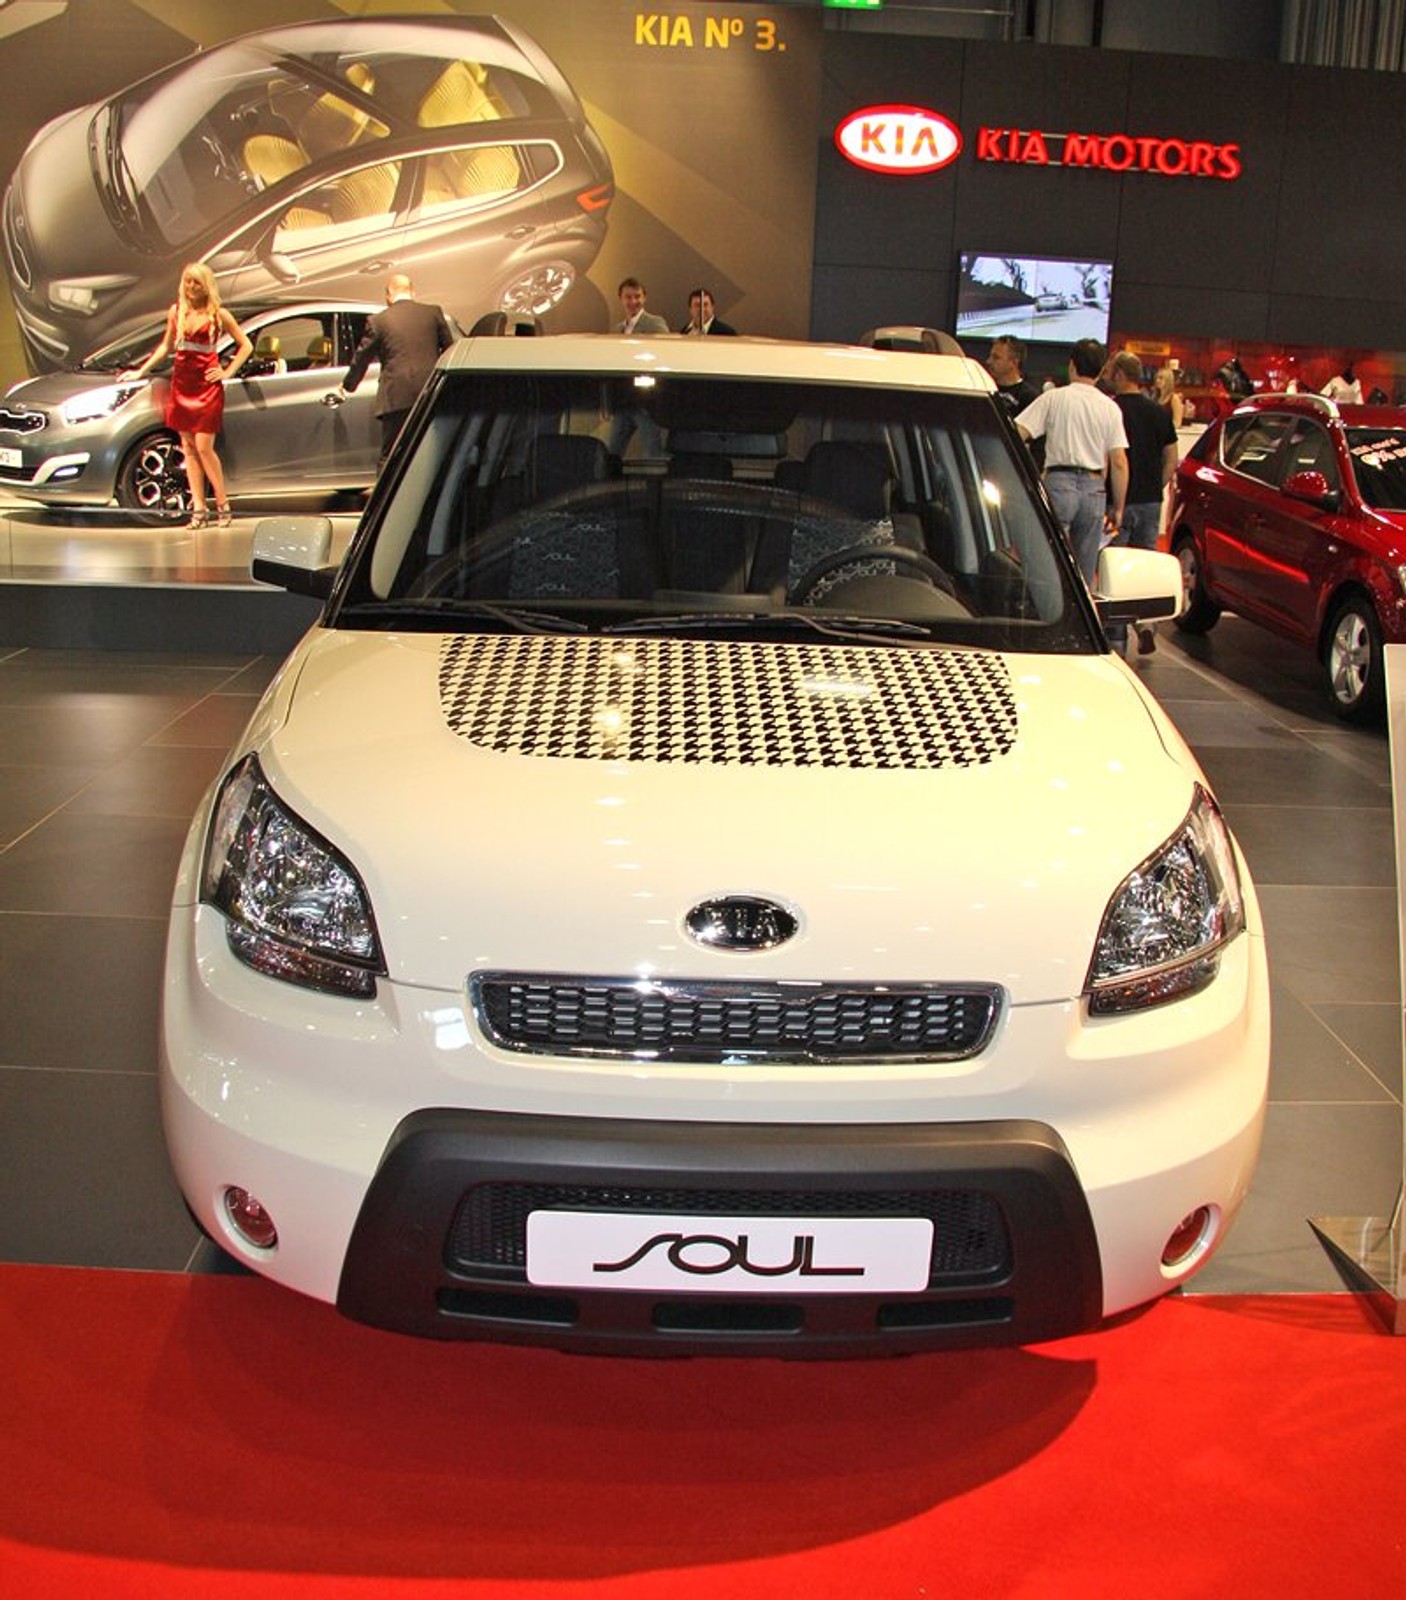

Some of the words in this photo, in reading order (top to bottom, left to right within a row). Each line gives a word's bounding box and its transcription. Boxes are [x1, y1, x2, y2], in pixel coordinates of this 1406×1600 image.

[635, 14, 694, 47] KIA
[754, 20, 786, 51] 3.
[860, 122, 939, 158] KIA
[977, 126, 1048, 164] KIA
[1062, 133, 1240, 180] MOTORS
[592, 1233, 865, 1276] SOUL
